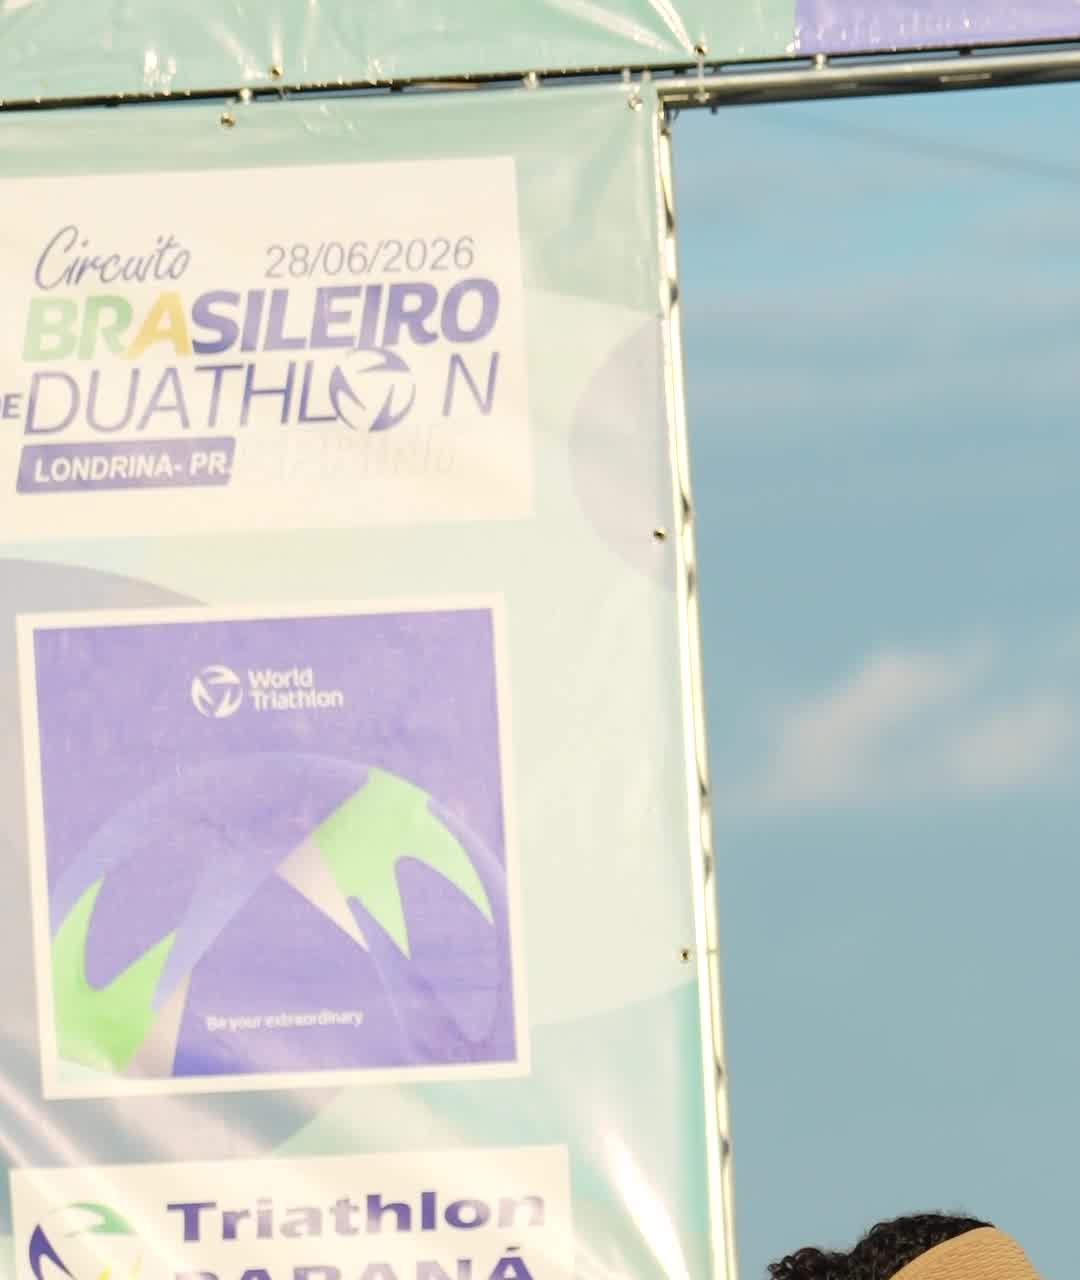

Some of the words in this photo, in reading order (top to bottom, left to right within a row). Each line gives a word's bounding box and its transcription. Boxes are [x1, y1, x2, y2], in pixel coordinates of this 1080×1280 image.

[34, 225, 191, 290] Circuito
[265, 236, 475, 279] 28/06/2026
[23, 278, 499, 361] BRASILEIRO
[248, 667, 312, 688] World
[251, 689, 344, 711] Triathlon
[167, 1190, 545, 1241] Triathlon
